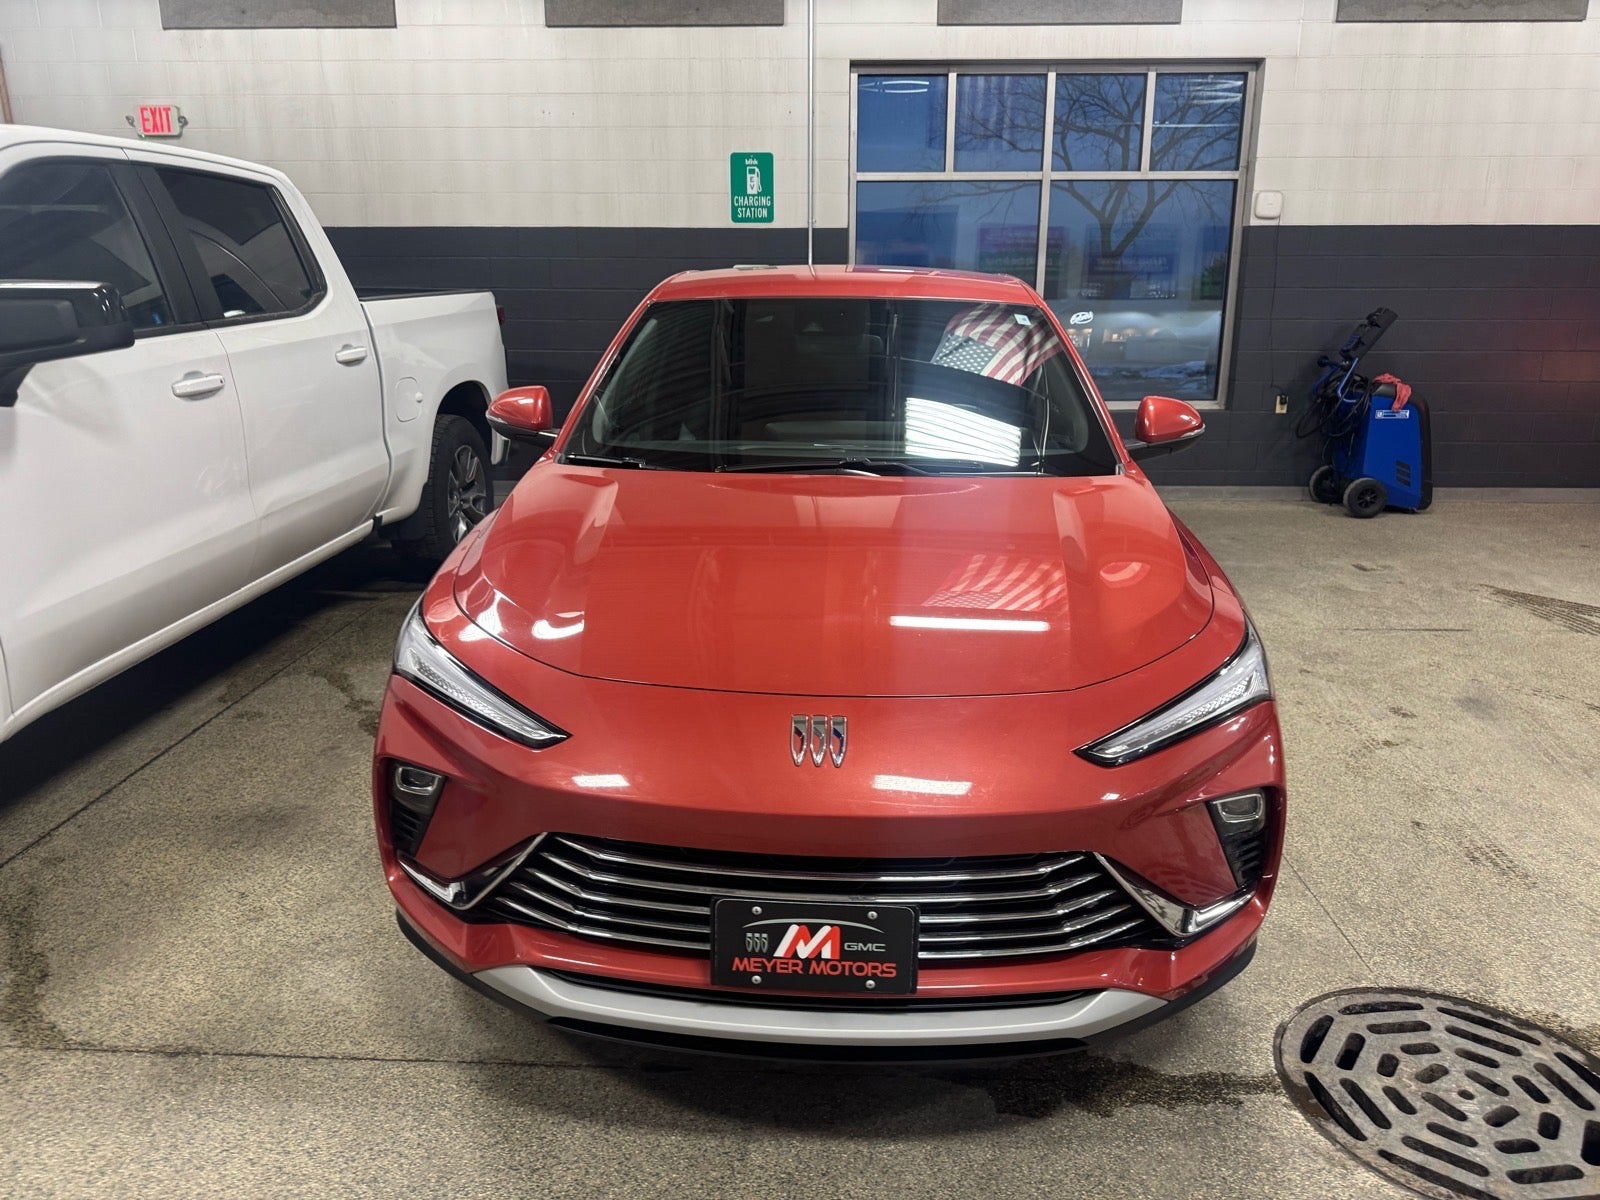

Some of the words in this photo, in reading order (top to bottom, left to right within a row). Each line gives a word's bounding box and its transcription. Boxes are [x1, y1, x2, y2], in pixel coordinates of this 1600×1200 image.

[139, 106, 172, 133] EXIT
[733, 195, 771, 207] CHARGING
[737, 207, 768, 218] STATION
[844, 942, 886, 952] GMC
[732, 956, 803, 975] MEYER
[809, 960, 897, 978] MOTORS
